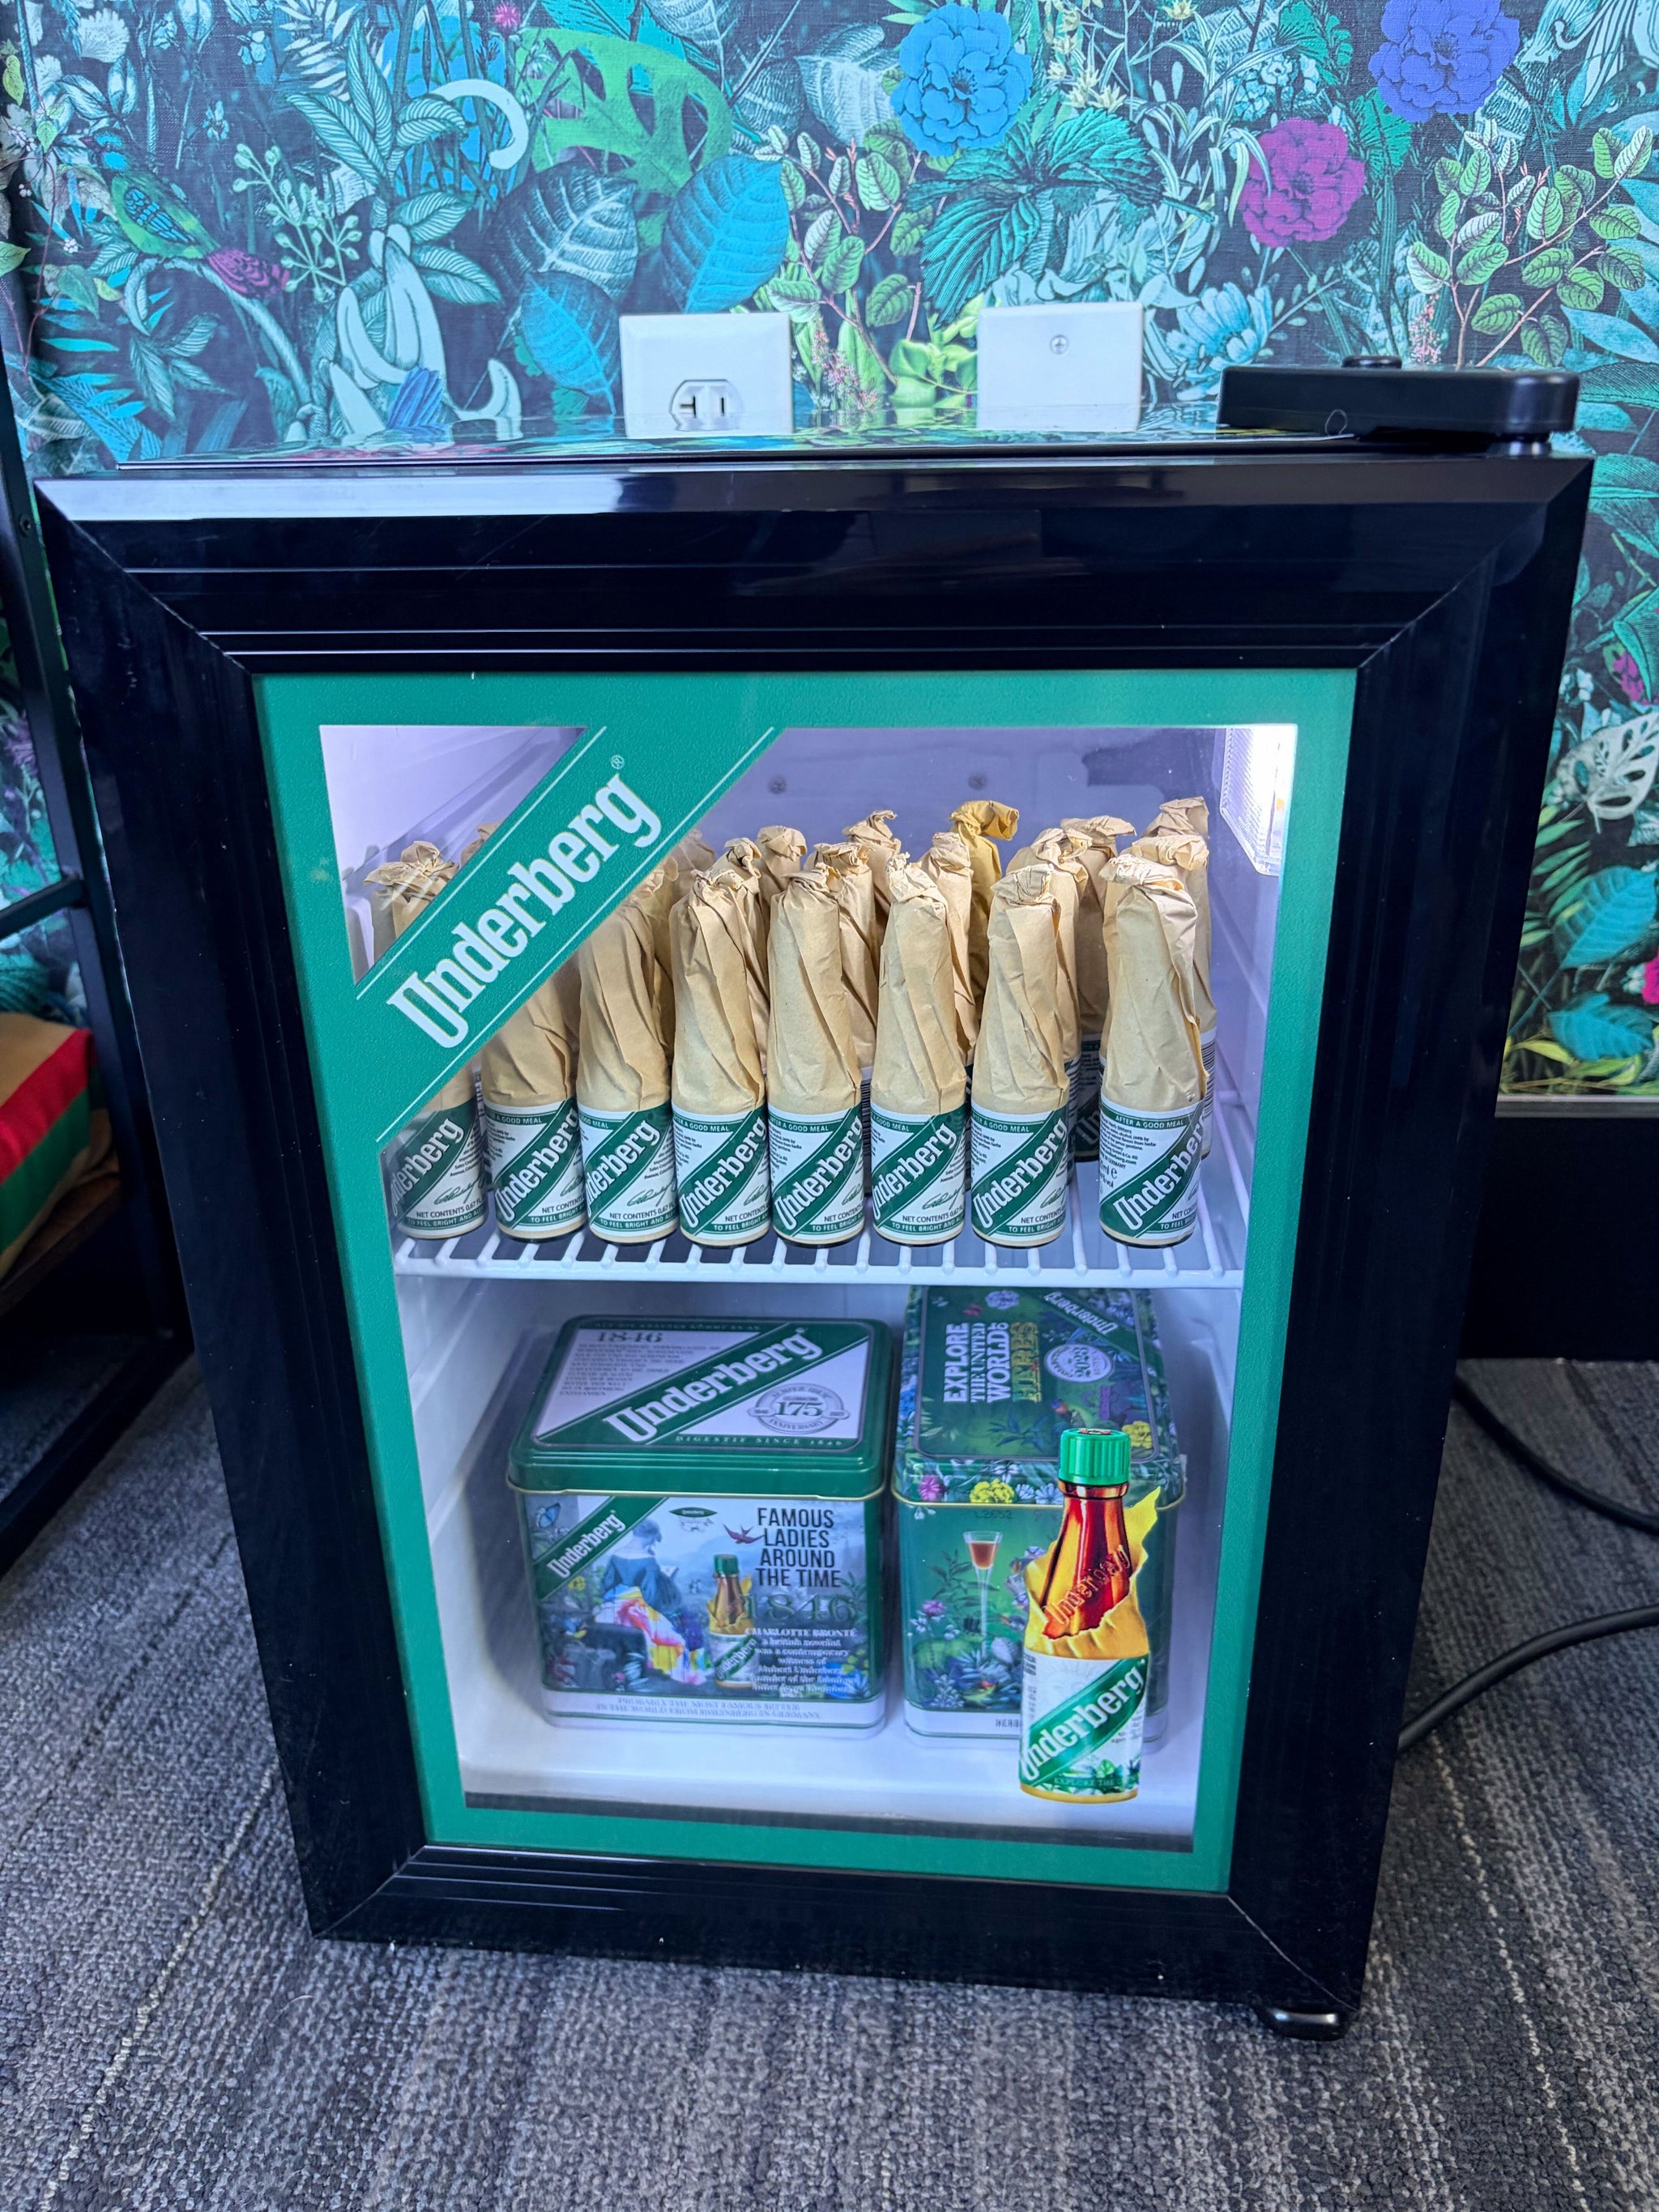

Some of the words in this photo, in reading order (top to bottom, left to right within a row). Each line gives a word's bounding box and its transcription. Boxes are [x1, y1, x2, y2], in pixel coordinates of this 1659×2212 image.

[386, 773, 661, 1049] Underberg
[501, 1116, 521, 1124] GOOD
[592, 1120, 608, 1128] MEAL
[876, 1117, 891, 1127] GOOD
[892, 1123, 909, 1132] MEAL
[989, 1122, 1008, 1131] GOOD
[1115, 1115, 1134, 1126] AFTER
[1143, 1121, 1165, 1129] GOOD
[1166, 1119, 1184, 1128] MEAL
[689, 1123, 709, 1132] GOOD
[788, 1123, 808, 1132] GOOD
[680, 1116, 767, 1229] Underberg
[430, 1205, 465, 1218] CONTENTS
[559, 1207, 578, 1221] BRIGHT
[623, 1209, 657, 1219] CONTENTS
[916, 1212, 949, 1223] CONTENTS
[1172, 1212, 1183, 1220] NET
[433, 1217, 458, 1227] BRIGHT
[459, 1213, 472, 1222] AND
[625, 1219, 649, 1229] BRIGHT
[651, 1217, 663, 1225] AND
[741, 1216, 761, 1229] BRIGHT
[902, 1224, 916, 1232] FEEL
[919, 1221, 942, 1232] BRIGHT
[944, 1219, 956, 1229] AND
[1037, 1220, 1056, 1231] BRIGHT
[1171, 1220, 1183, 1229] FEEL
[1044, 1291, 1120, 1335] Underberg
[970, 1322, 986, 1374] UNITED
[944, 1322, 970, 1403] EXPLORE
[987, 1331, 1011, 1403] WORLD
[1011, 1321, 1042, 1404] HERBS
[603, 1332, 823, 1443] Underberg
[970, 1375, 985, 1403] THE
[774, 1401, 823, 1416] 175
[676, 1435, 747, 1443] DIGESTIF
[757, 1507, 834, 1528] FAMOUS
[764, 1528, 830, 1548] LADIES
[547, 1512, 627, 1579] Underberg
[760, 1549, 834, 1568] AROUND
[755, 1568, 791, 1587] THE
[796, 1569, 841, 1588] TIME
[1044, 1544, 1131, 1626] Underberg
[744, 1628, 810, 1636] CHARLOTTE
[1021, 1666, 1145, 1780] Underberg
